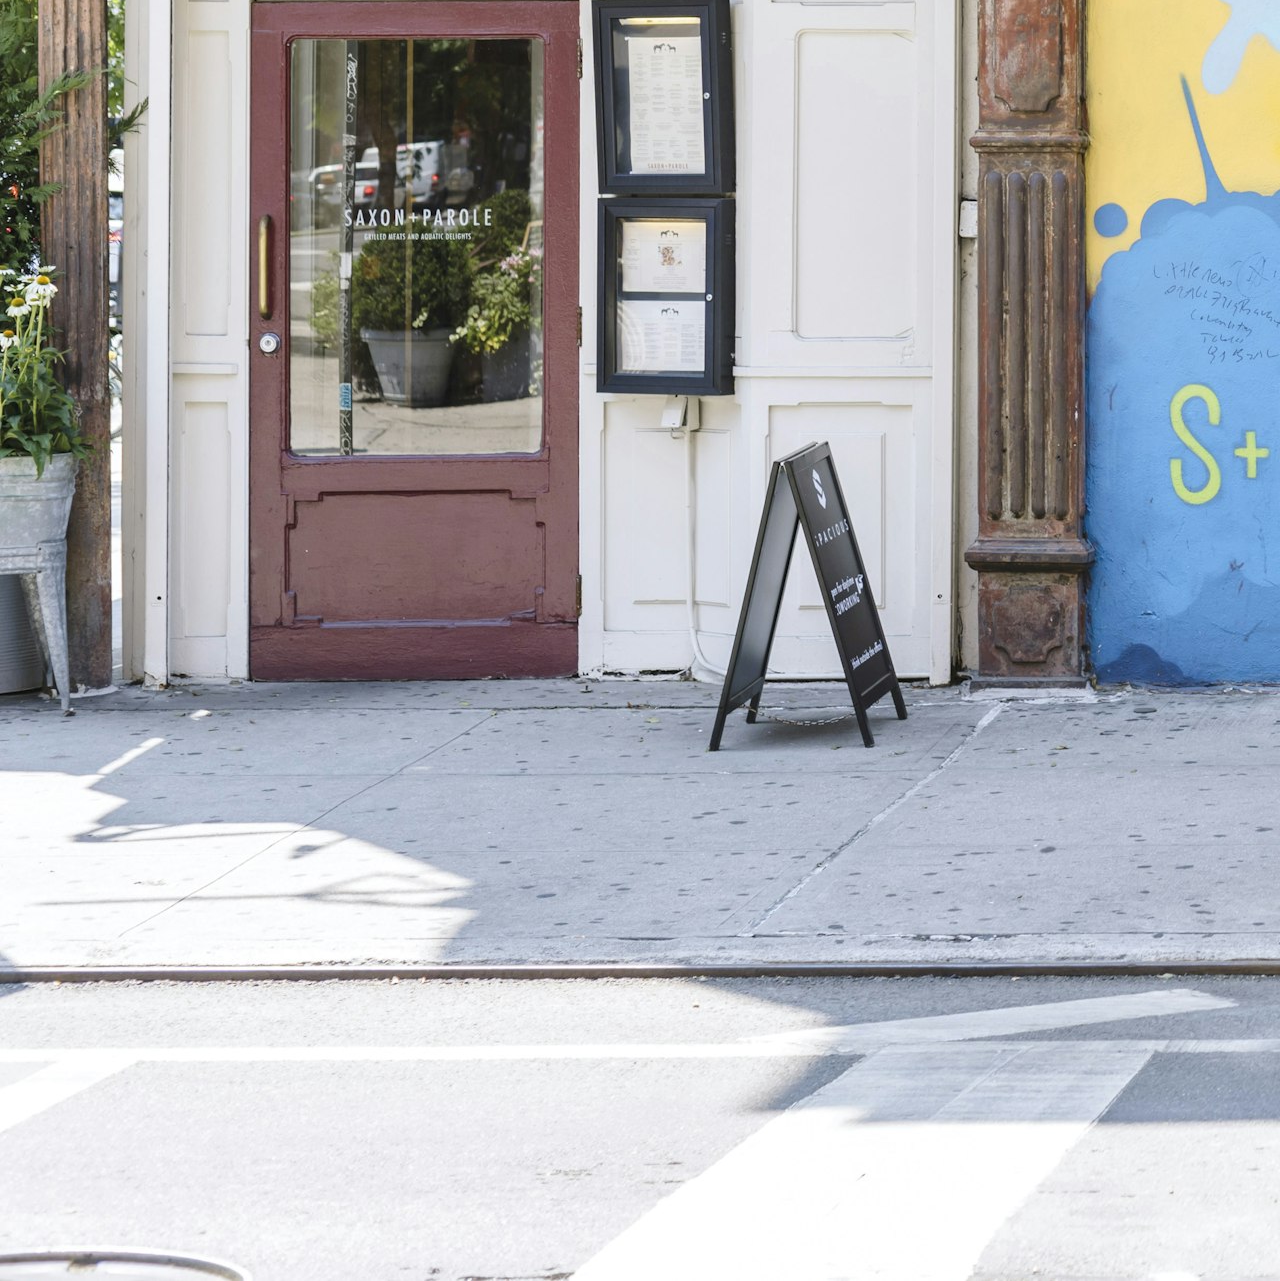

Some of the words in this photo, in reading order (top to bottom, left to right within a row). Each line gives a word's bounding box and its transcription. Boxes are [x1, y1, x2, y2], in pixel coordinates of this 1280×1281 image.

[364, 232, 387, 241] GRILLED
[388, 232, 406, 241] MEATS
[407, 232, 419, 241] AND
[420, 232, 444, 241] AQUATIC
[445, 232, 472, 241] DELIGHTS
